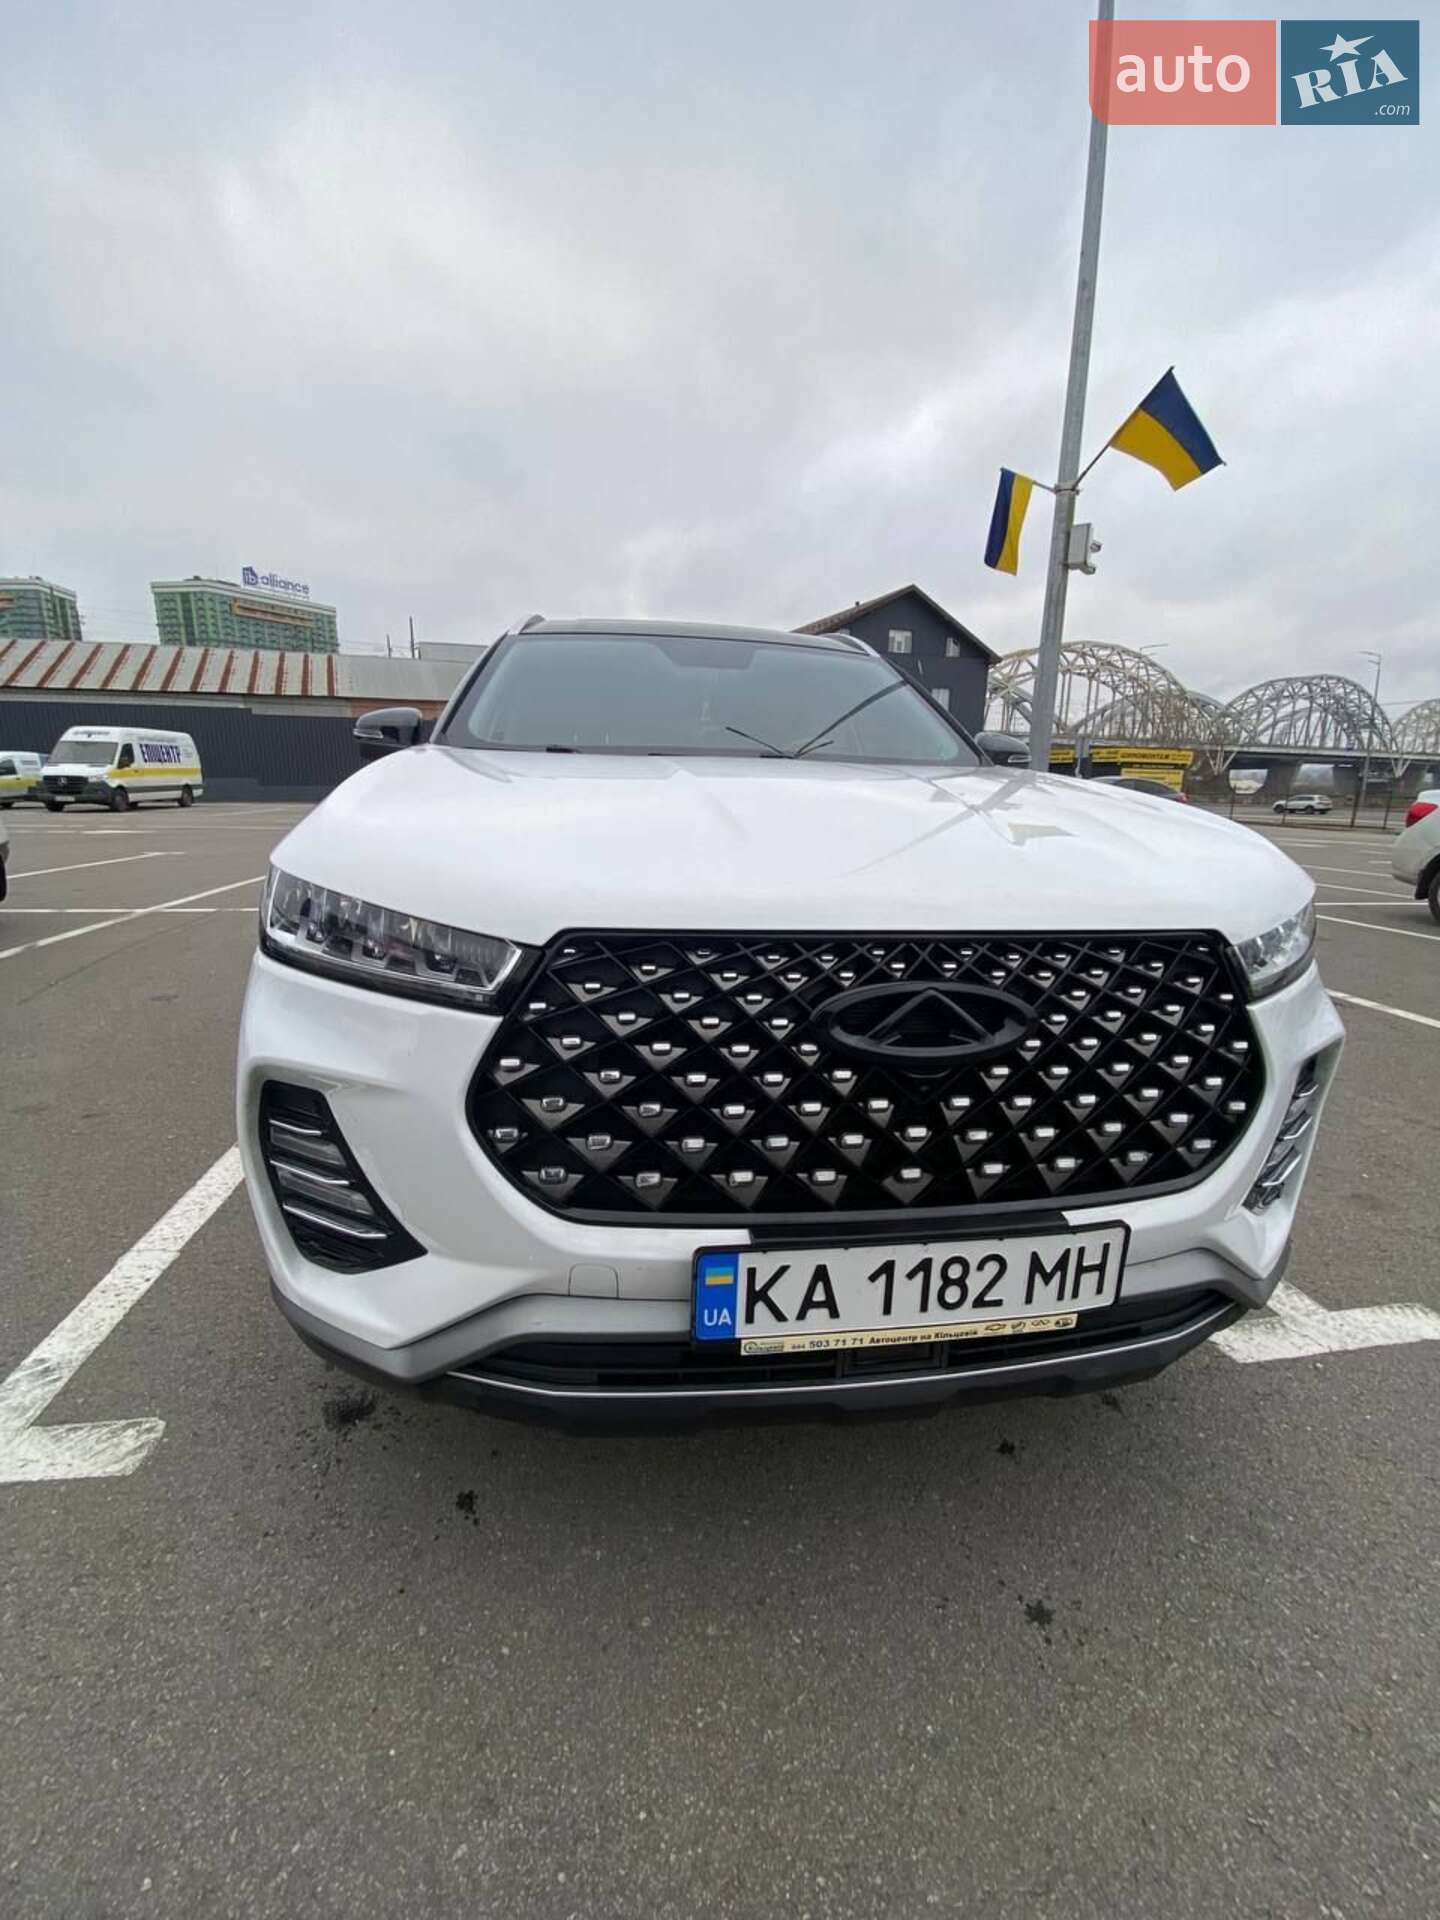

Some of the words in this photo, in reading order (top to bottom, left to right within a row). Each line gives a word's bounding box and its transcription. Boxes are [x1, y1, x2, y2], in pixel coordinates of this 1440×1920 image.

[261, 572, 310, 594] alliance
[868, 1254, 1008, 1316] 1182
[703, 1308, 732, 1327] UA
[809, 1338, 830, 1349] 503
[833, 1338, 847, 1347] 71
[851, 1337, 864, 1346] 71
